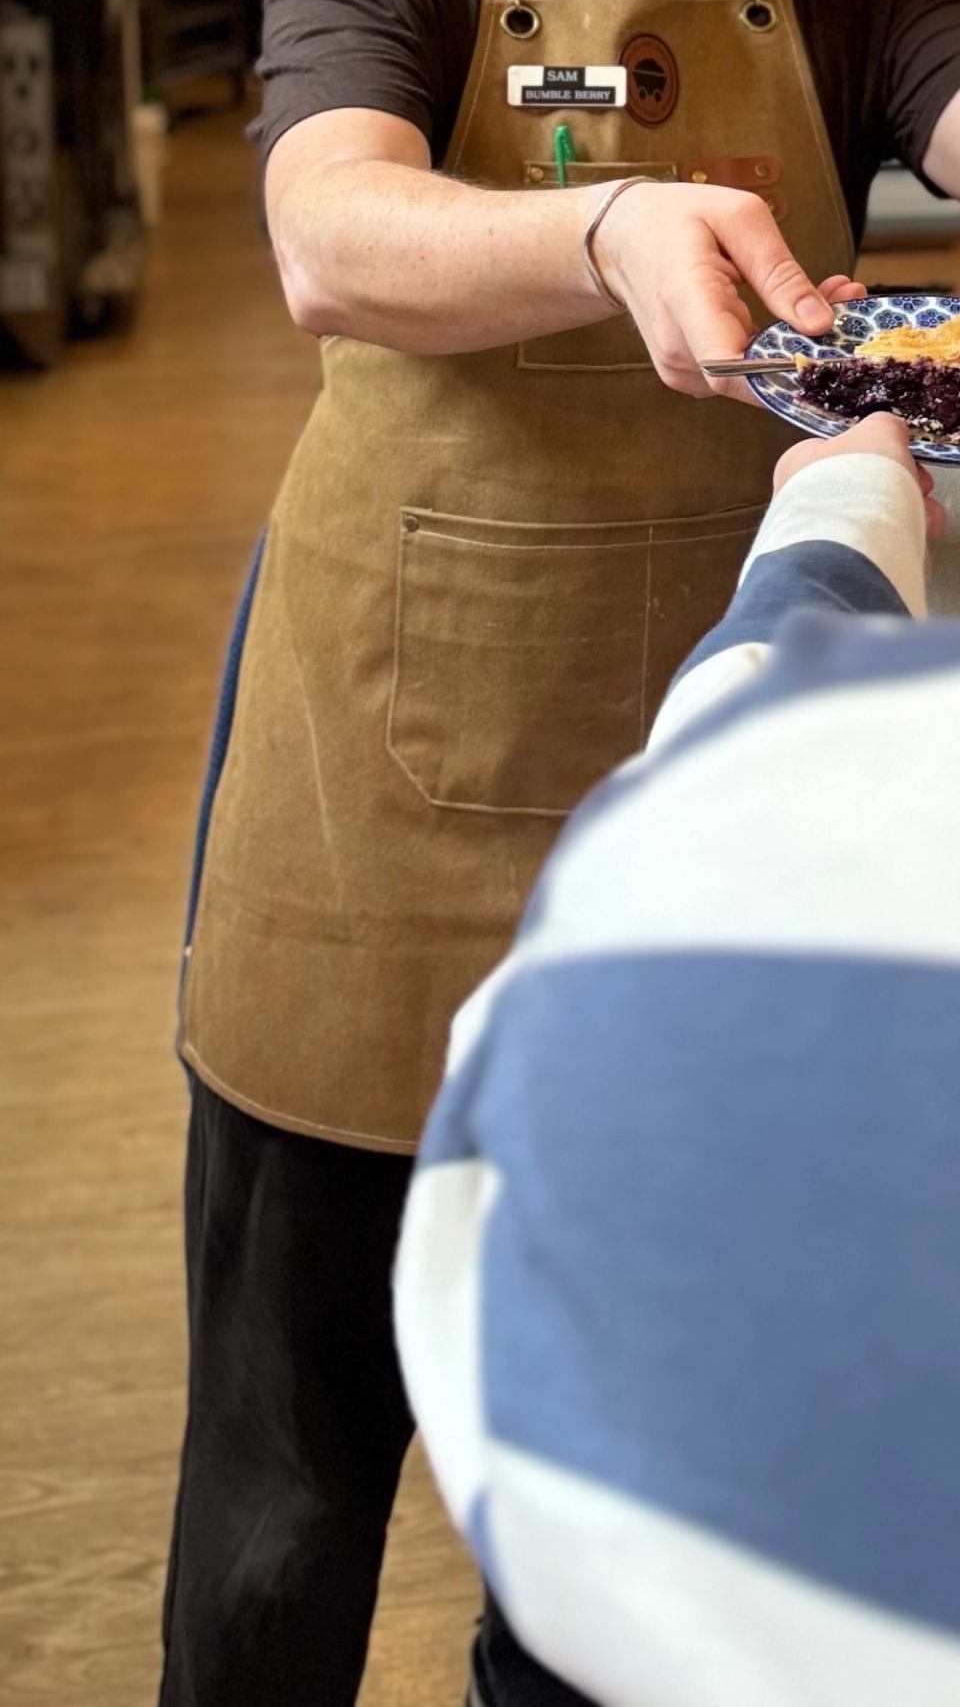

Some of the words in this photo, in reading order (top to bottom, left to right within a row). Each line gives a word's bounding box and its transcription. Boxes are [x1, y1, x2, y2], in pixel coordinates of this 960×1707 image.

[546, 70, 578, 82] SAM
[525, 90, 572, 100] BUMBLE
[574, 90, 611, 100] BERRY
